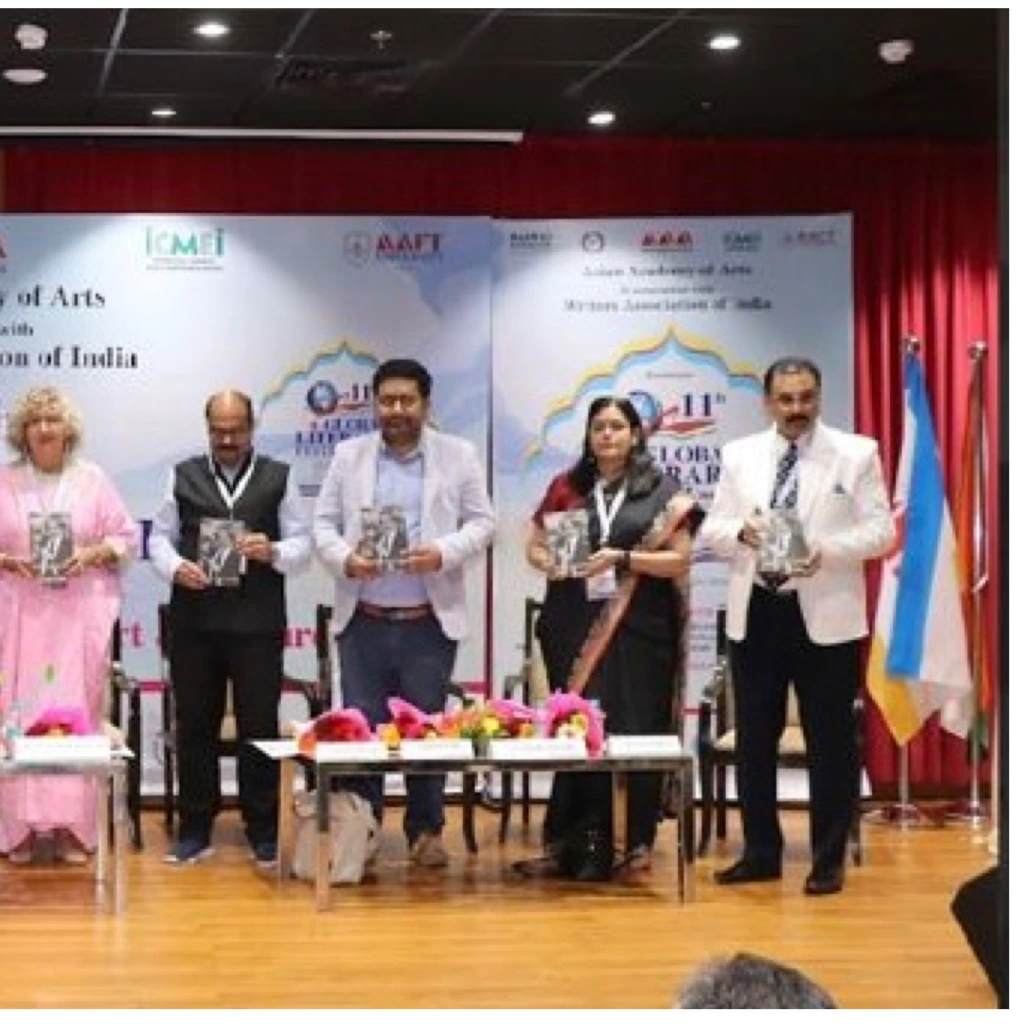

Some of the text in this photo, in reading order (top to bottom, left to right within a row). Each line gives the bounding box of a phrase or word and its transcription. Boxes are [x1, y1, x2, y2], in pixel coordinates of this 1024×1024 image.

[17, 284, 43, 307] of
[51, 285, 106, 309] Arts
[38, 345, 62, 368] of
[71, 346, 139, 369] India
